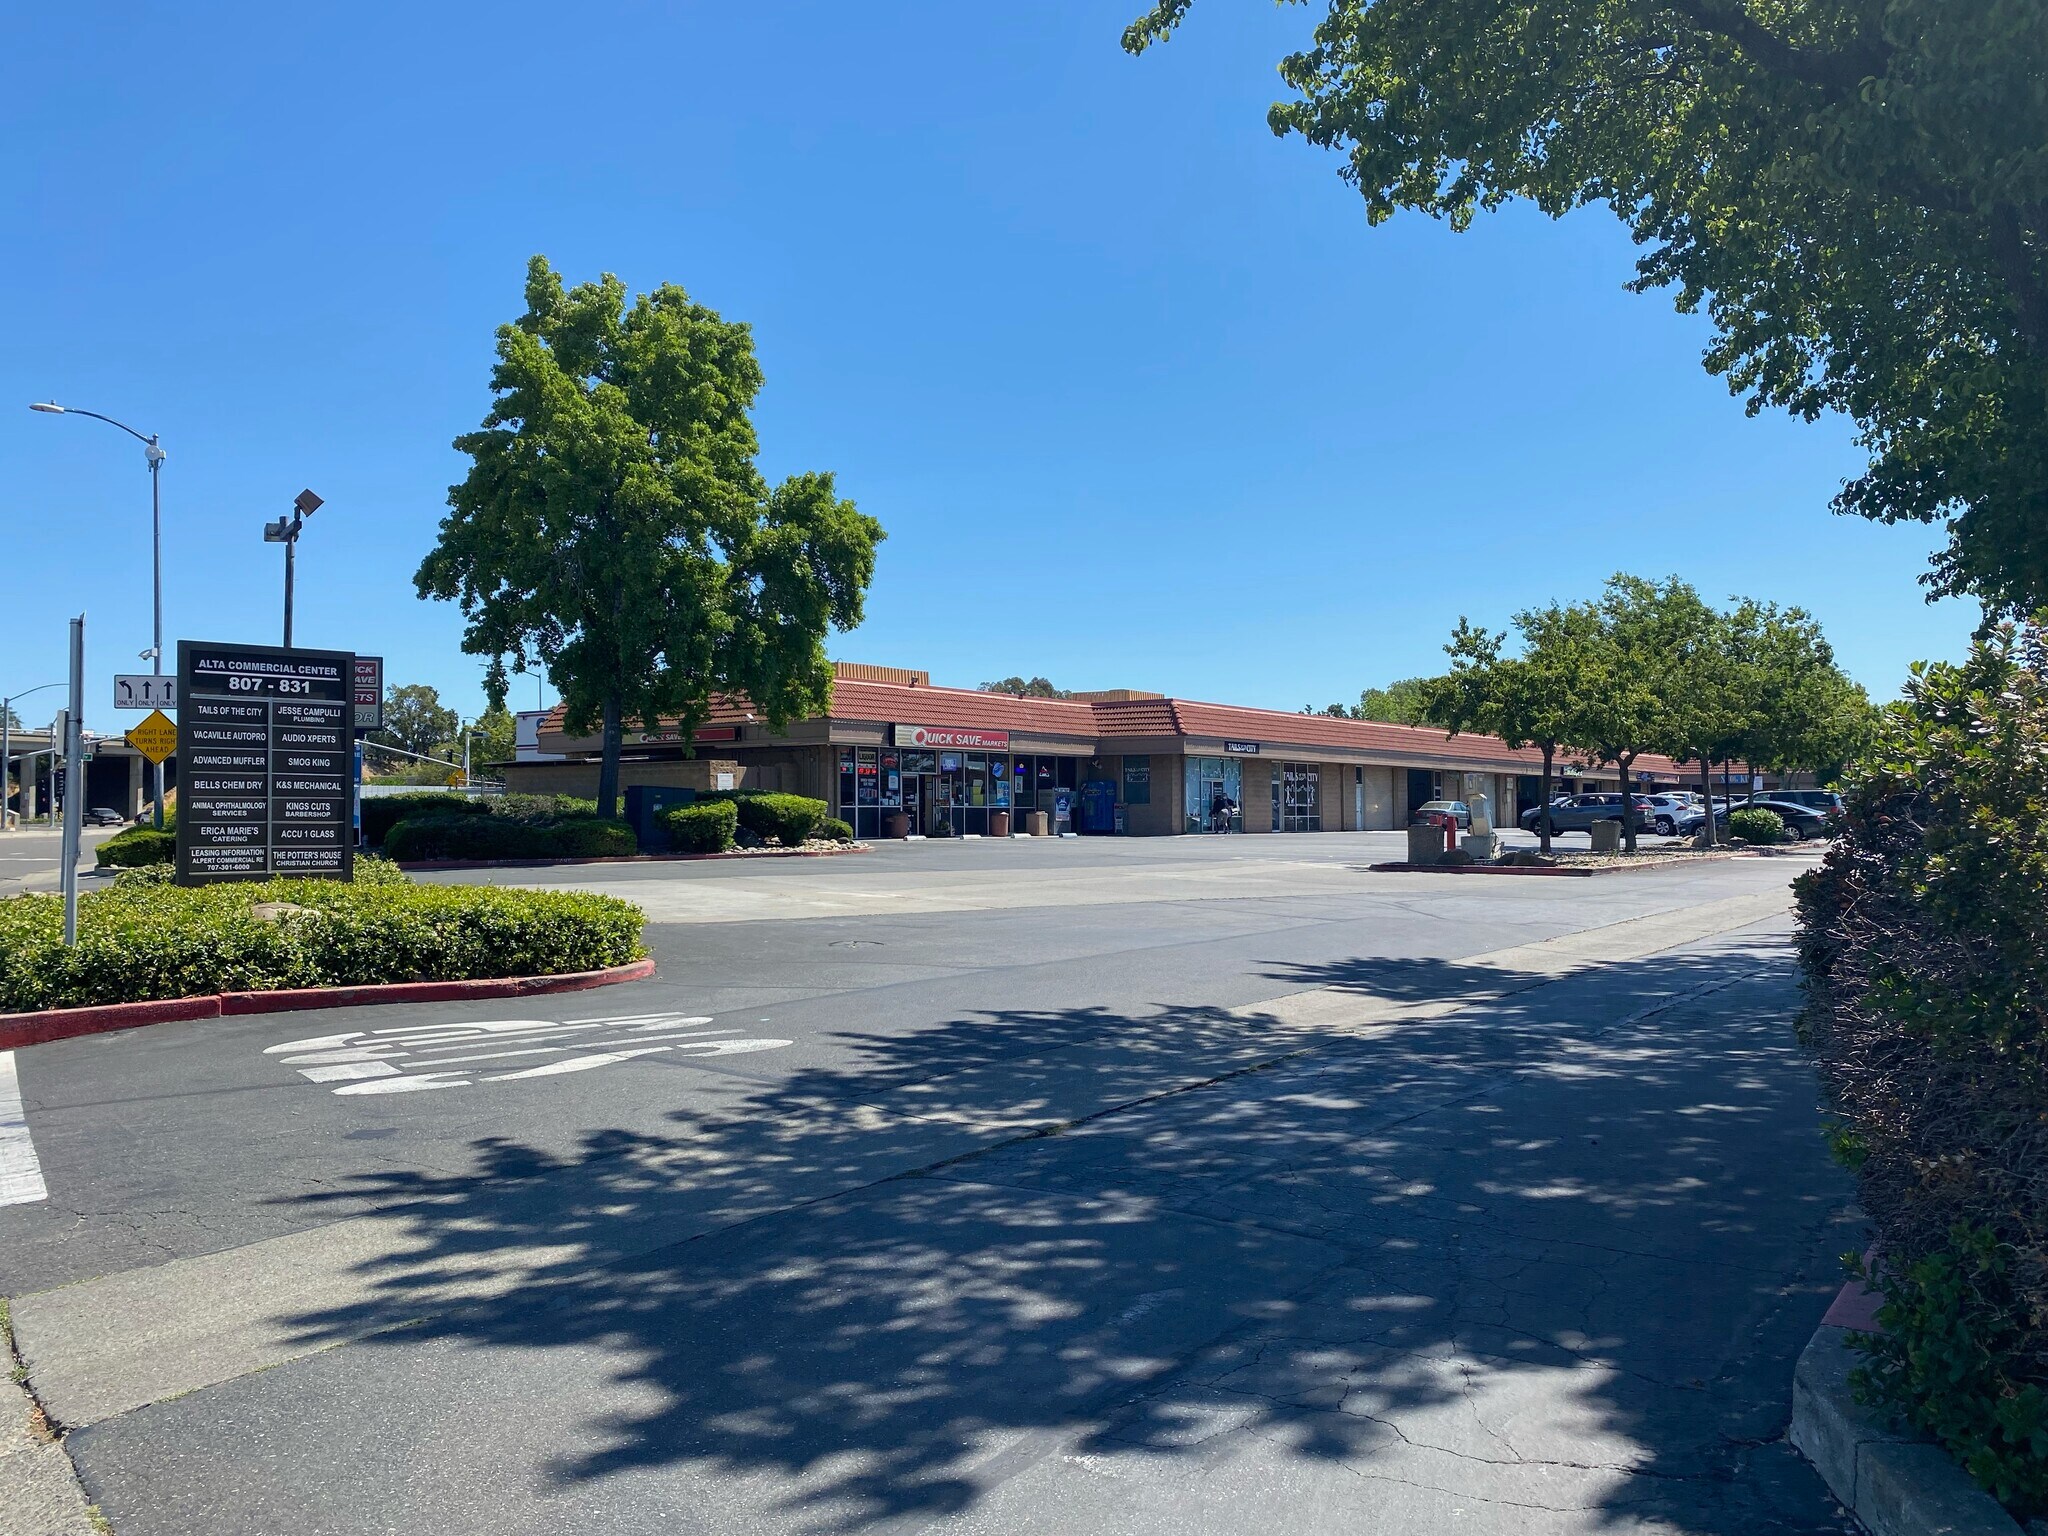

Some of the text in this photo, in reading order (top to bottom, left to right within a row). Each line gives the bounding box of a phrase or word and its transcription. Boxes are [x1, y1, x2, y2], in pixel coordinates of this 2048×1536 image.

[198, 659, 337, 675] ALTA COMMERCIAL CENTER
[229, 677, 262, 690] 807
[279, 679, 310, 694] 831
[198, 705, 219, 714] TAILS
[232, 707, 245, 715] THE
[247, 708, 262, 716] CITY
[278, 706, 340, 717] JESSE CAMPULLI
[194, 730, 266, 741] VACAVILLE AUTOPRO
[282, 734, 336, 744] AUDIO XPERTS
[910, 727, 1007, 748] QUICK SAVE MARKETS
[1228, 743, 1241, 751] TAILS
[1246, 745, 1257, 753] CITY
[193, 756, 265, 765] ADVANCED MUFFLER
[288, 758, 330, 767] SMOG KING
[1284, 772, 1298, 781] TAILS
[1308, 773, 1318, 781] CITY
[194, 781, 220, 789] BELLS
[222, 781, 245, 789] CHEM
[276, 781, 341, 790] K&S MECHANICAL
[215, 802, 266, 810] OPHTHALMOLOGY
[311, 803, 330, 811] CUTS
[201, 827, 259, 835] ERICA MARIE'S
[281, 830, 335, 838] ACCU 1 GLASS
[287, 851, 319, 859] POTTER'S
[320, 851, 341, 859] HOUSE
